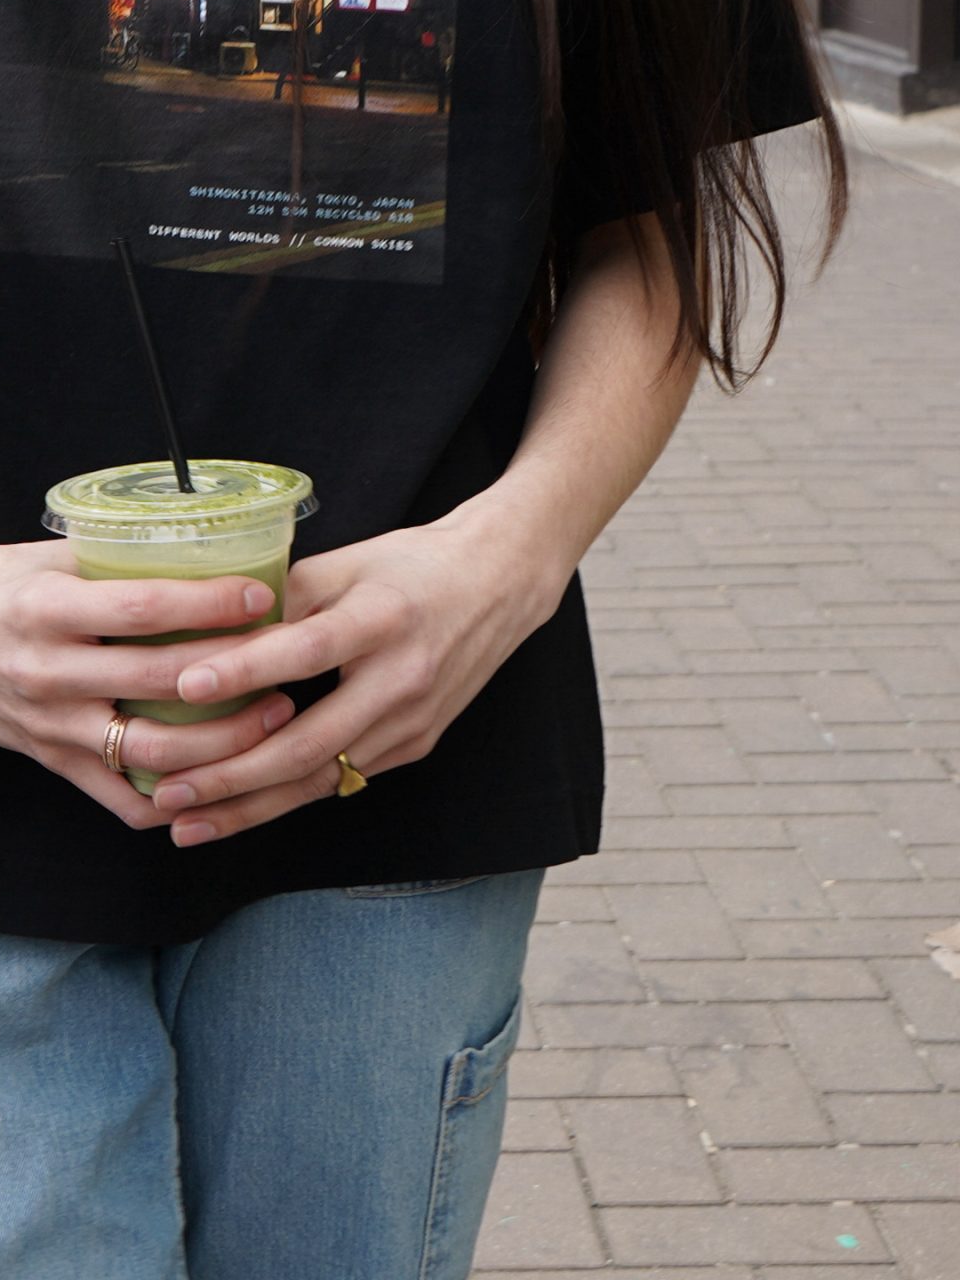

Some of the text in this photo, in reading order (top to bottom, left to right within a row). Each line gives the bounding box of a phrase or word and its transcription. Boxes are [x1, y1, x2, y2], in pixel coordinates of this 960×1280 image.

[316, 193, 363, 208] TOKYO,
[372, 197, 415, 209] JAPAN
[315, 207, 381, 221] RECYCLED
[388, 211, 414, 223] AIR
[149, 224, 222, 240] DIFFERENT
[229, 231, 280, 244] WORLDS
[313, 236, 364, 249] COMMON
[370, 238, 414, 251] SKIES
